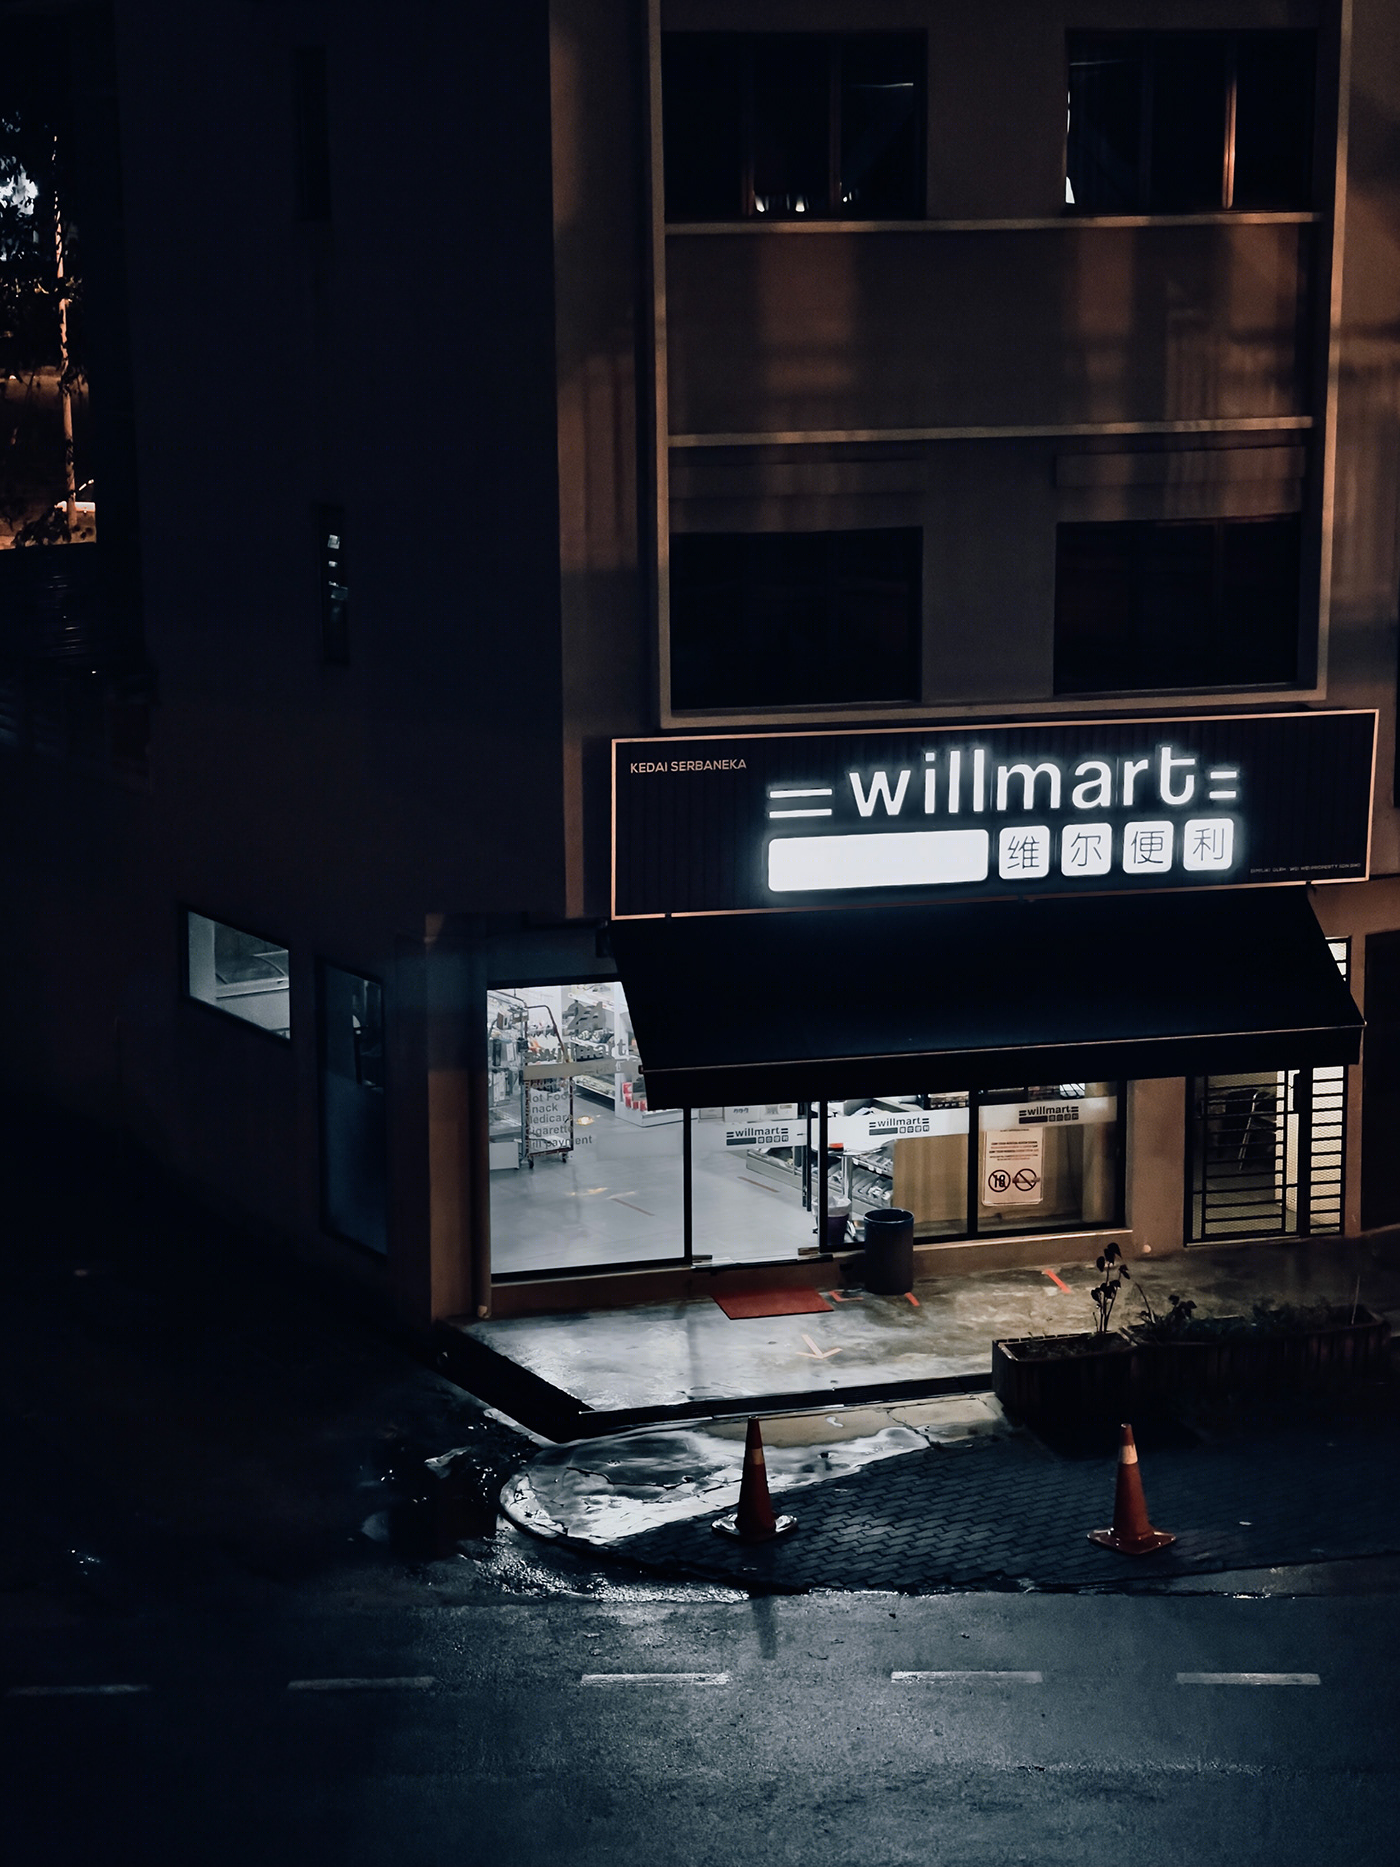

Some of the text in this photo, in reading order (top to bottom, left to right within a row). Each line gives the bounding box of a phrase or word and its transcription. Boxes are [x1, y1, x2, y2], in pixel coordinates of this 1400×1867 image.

[630, 758, 747, 774] KEDAI SERBANEKA
[849, 746, 1196, 817] willmart
[1006, 827, 1225, 869] 维尔便利
[546, 1090, 573, 1101] Foo
[526, 1103, 558, 1114] nack
[1027, 1105, 1070, 1116] willmart
[877, 1117, 921, 1127] willmart
[735, 1127, 780, 1137] willmart
